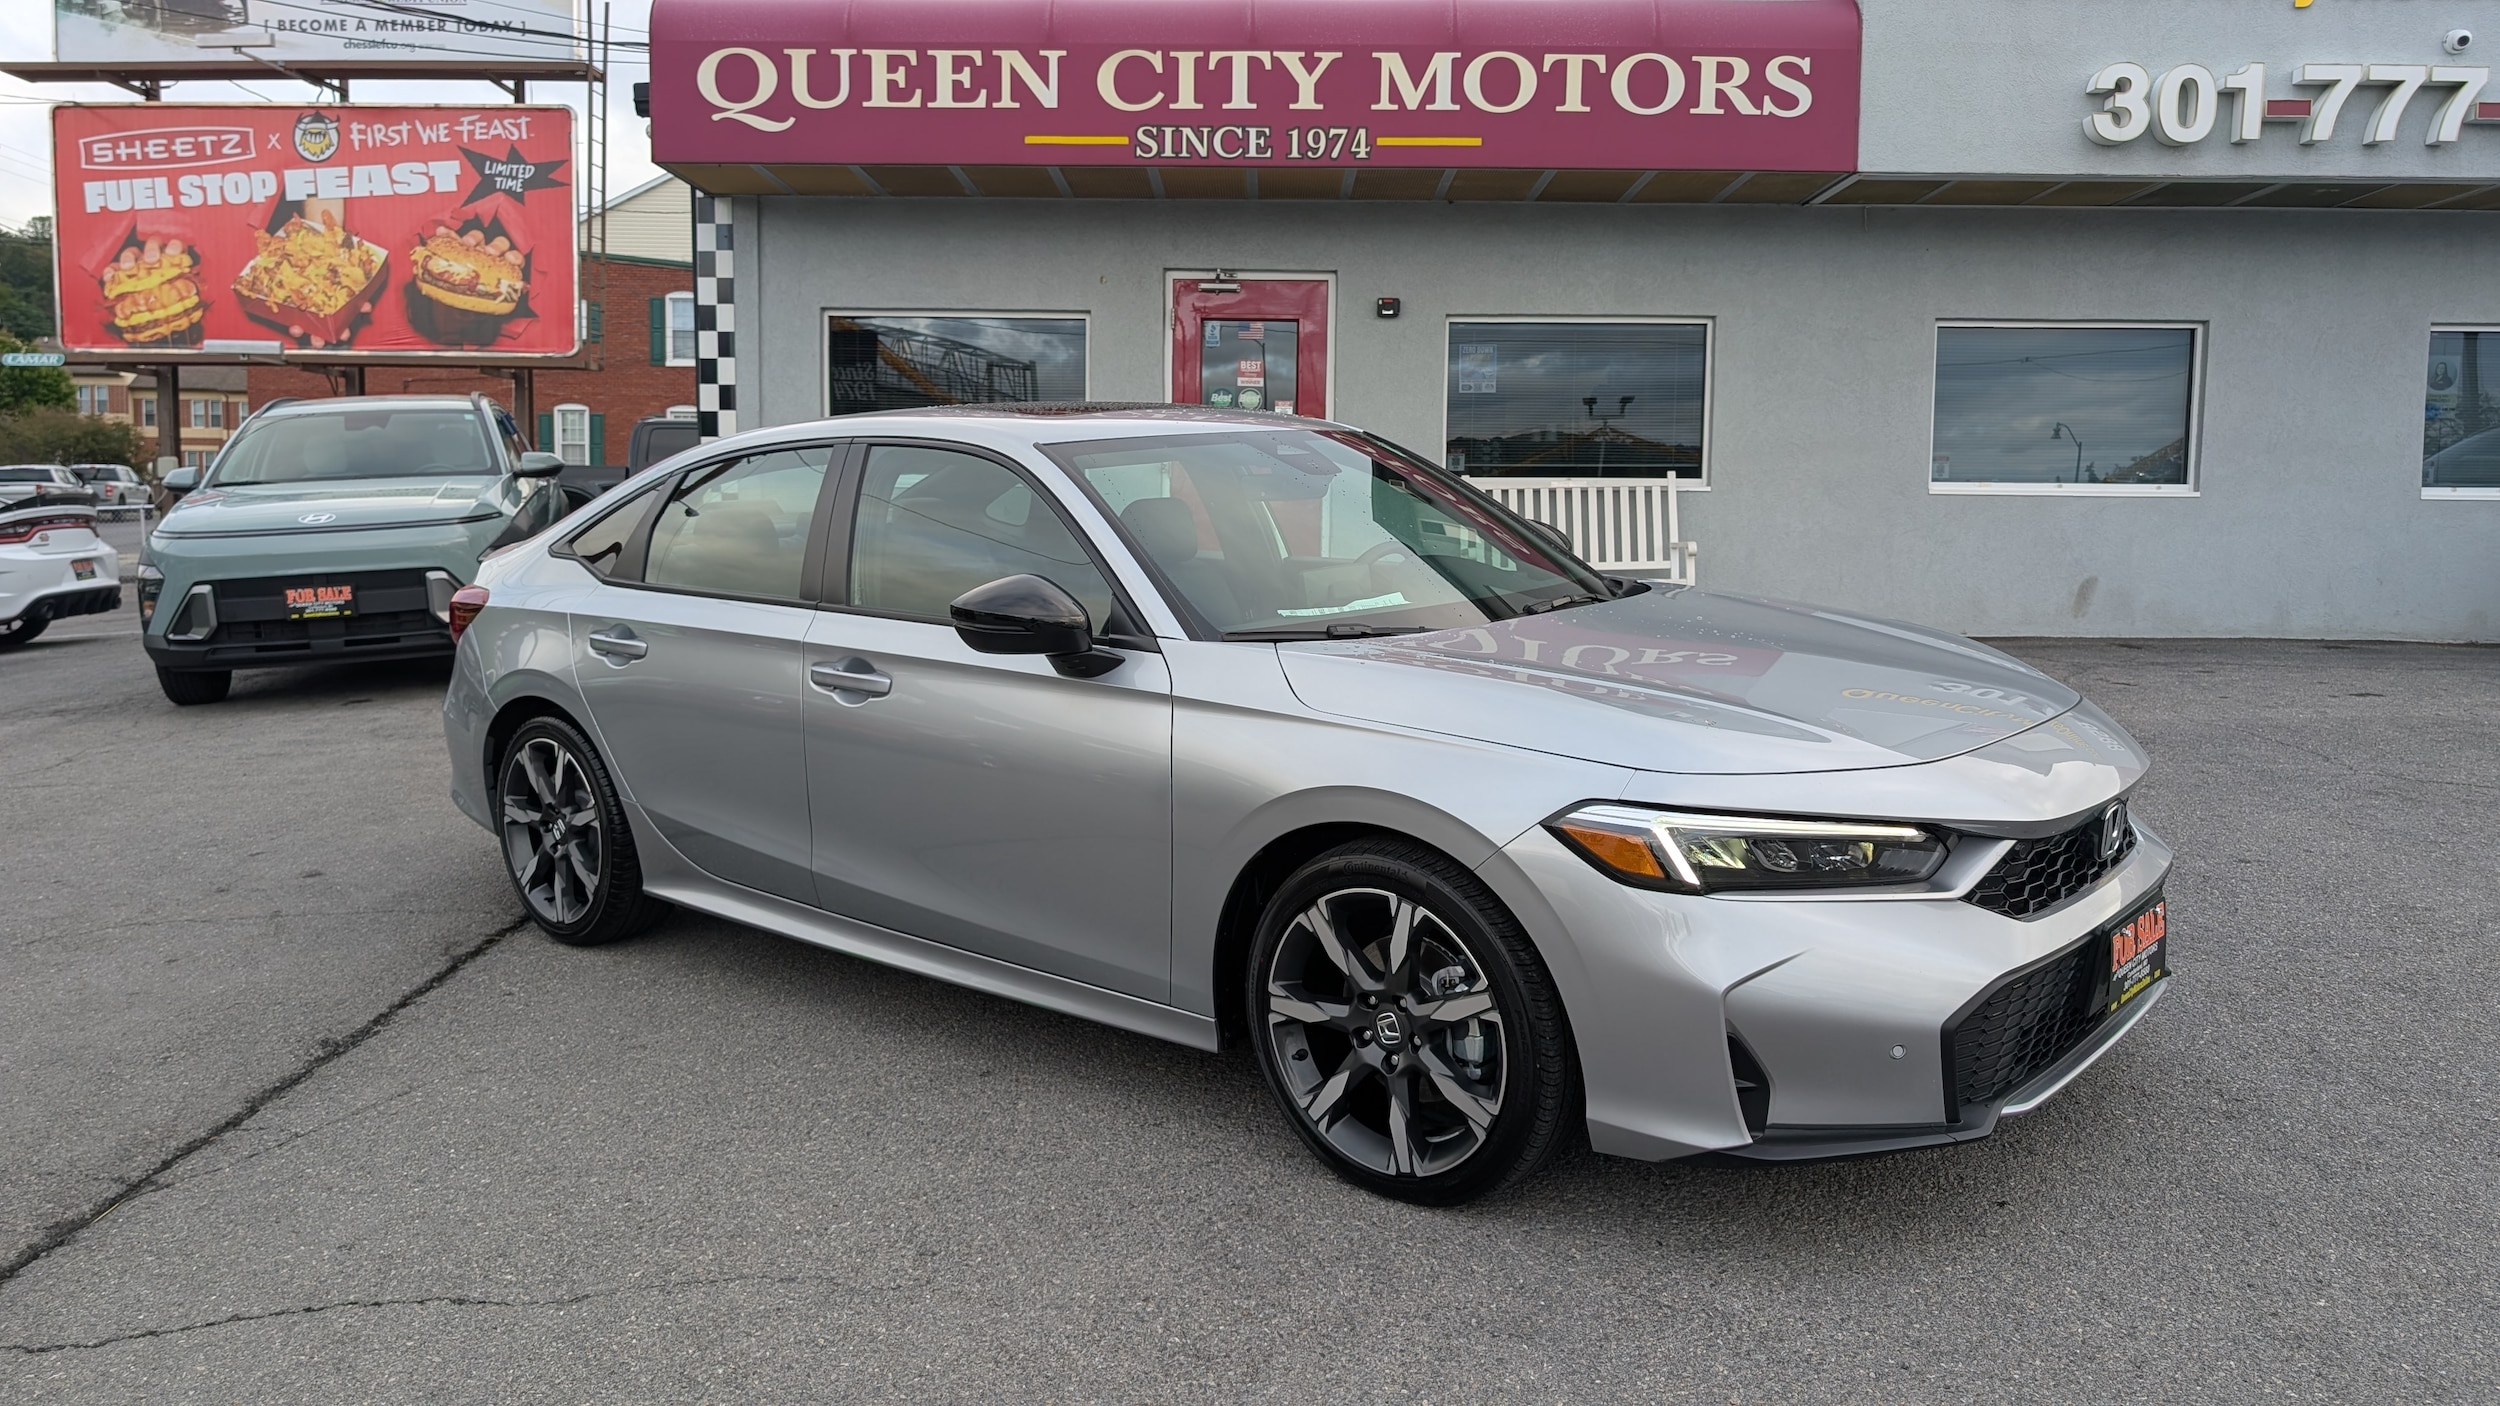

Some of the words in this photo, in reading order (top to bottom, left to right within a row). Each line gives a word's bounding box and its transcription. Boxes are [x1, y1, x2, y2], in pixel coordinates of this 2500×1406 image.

[277, 19, 348, 32] BECOME
[355, 19, 367, 32] A
[375, 19, 447, 32] MEMBER
[454, 20, 513, 33] TODAY
[697, 47, 1067, 132] QUEEN
[1096, 49, 1343, 112] CITY
[1370, 50, 1813, 118] MOTORS
[91, 134, 242, 163] SHEETZ
[350, 121, 412, 151] FIRST
[415, 119, 451, 145] WE
[453, 114, 532, 144] FEAST
[1135, 125, 1272, 159] SINCE
[1287, 127, 1371, 159] 1974
[484, 160, 535, 179] LIMITED
[83, 176, 174, 213] FUEL
[178, 171, 278, 207] STOP
[283, 160, 461, 201] FEAST
[494, 177, 524, 192] TIME
[7, 354, 59, 365] LAMAR
[1240, 361, 1261, 370] BEST
[1211, 393, 1232, 402] Best
[286, 587, 316, 604] FOR
[317, 586, 352, 601] SALE
[2112, 923, 2136, 972] FOR
[2137, 902, 2165, 953] SALE
